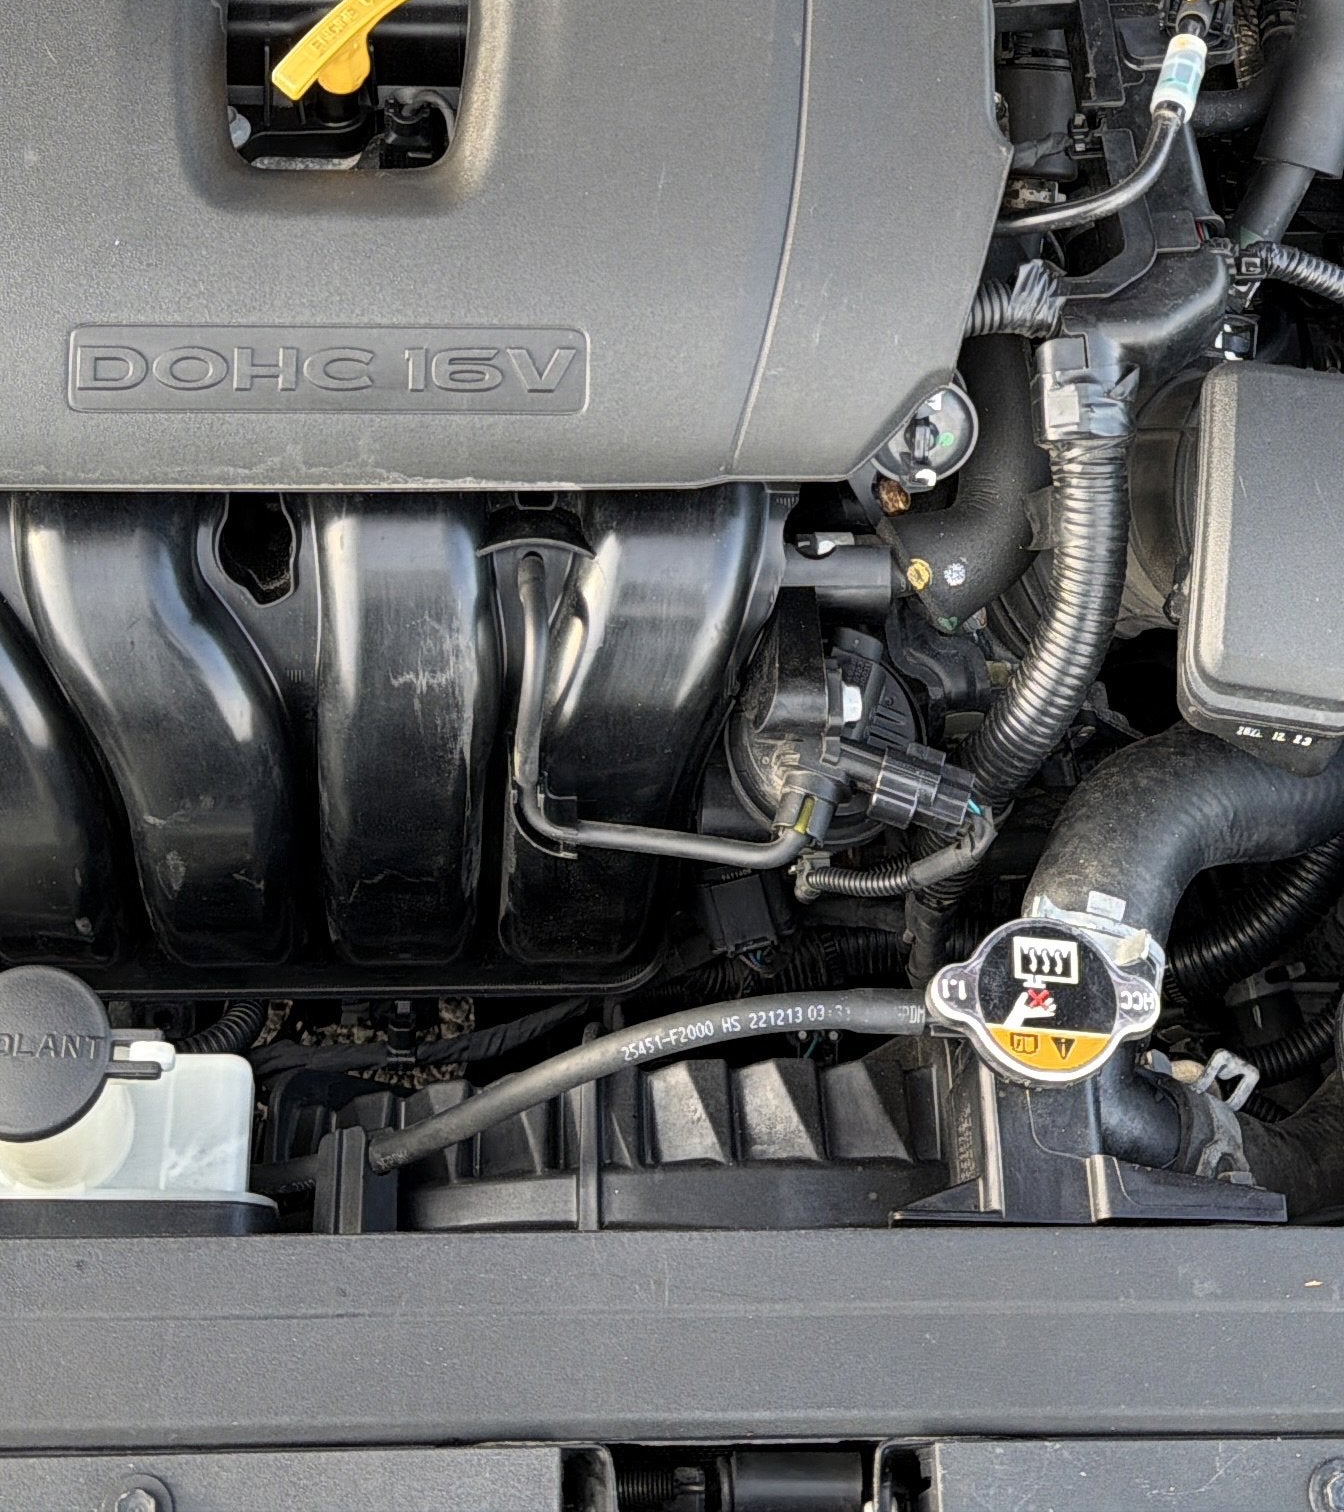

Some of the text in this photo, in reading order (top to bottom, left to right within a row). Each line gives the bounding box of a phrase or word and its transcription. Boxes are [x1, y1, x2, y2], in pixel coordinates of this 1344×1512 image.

[76, 345, 578, 393] DOHC 16V
[942, 978, 967, 1000] 1.1
[1120, 990, 1154, 1011] HCC
[621, 1019, 715, 1062] 25451-F2000
[721, 1015, 741, 1034] HS
[749, 1006, 803, 1029] 221213
